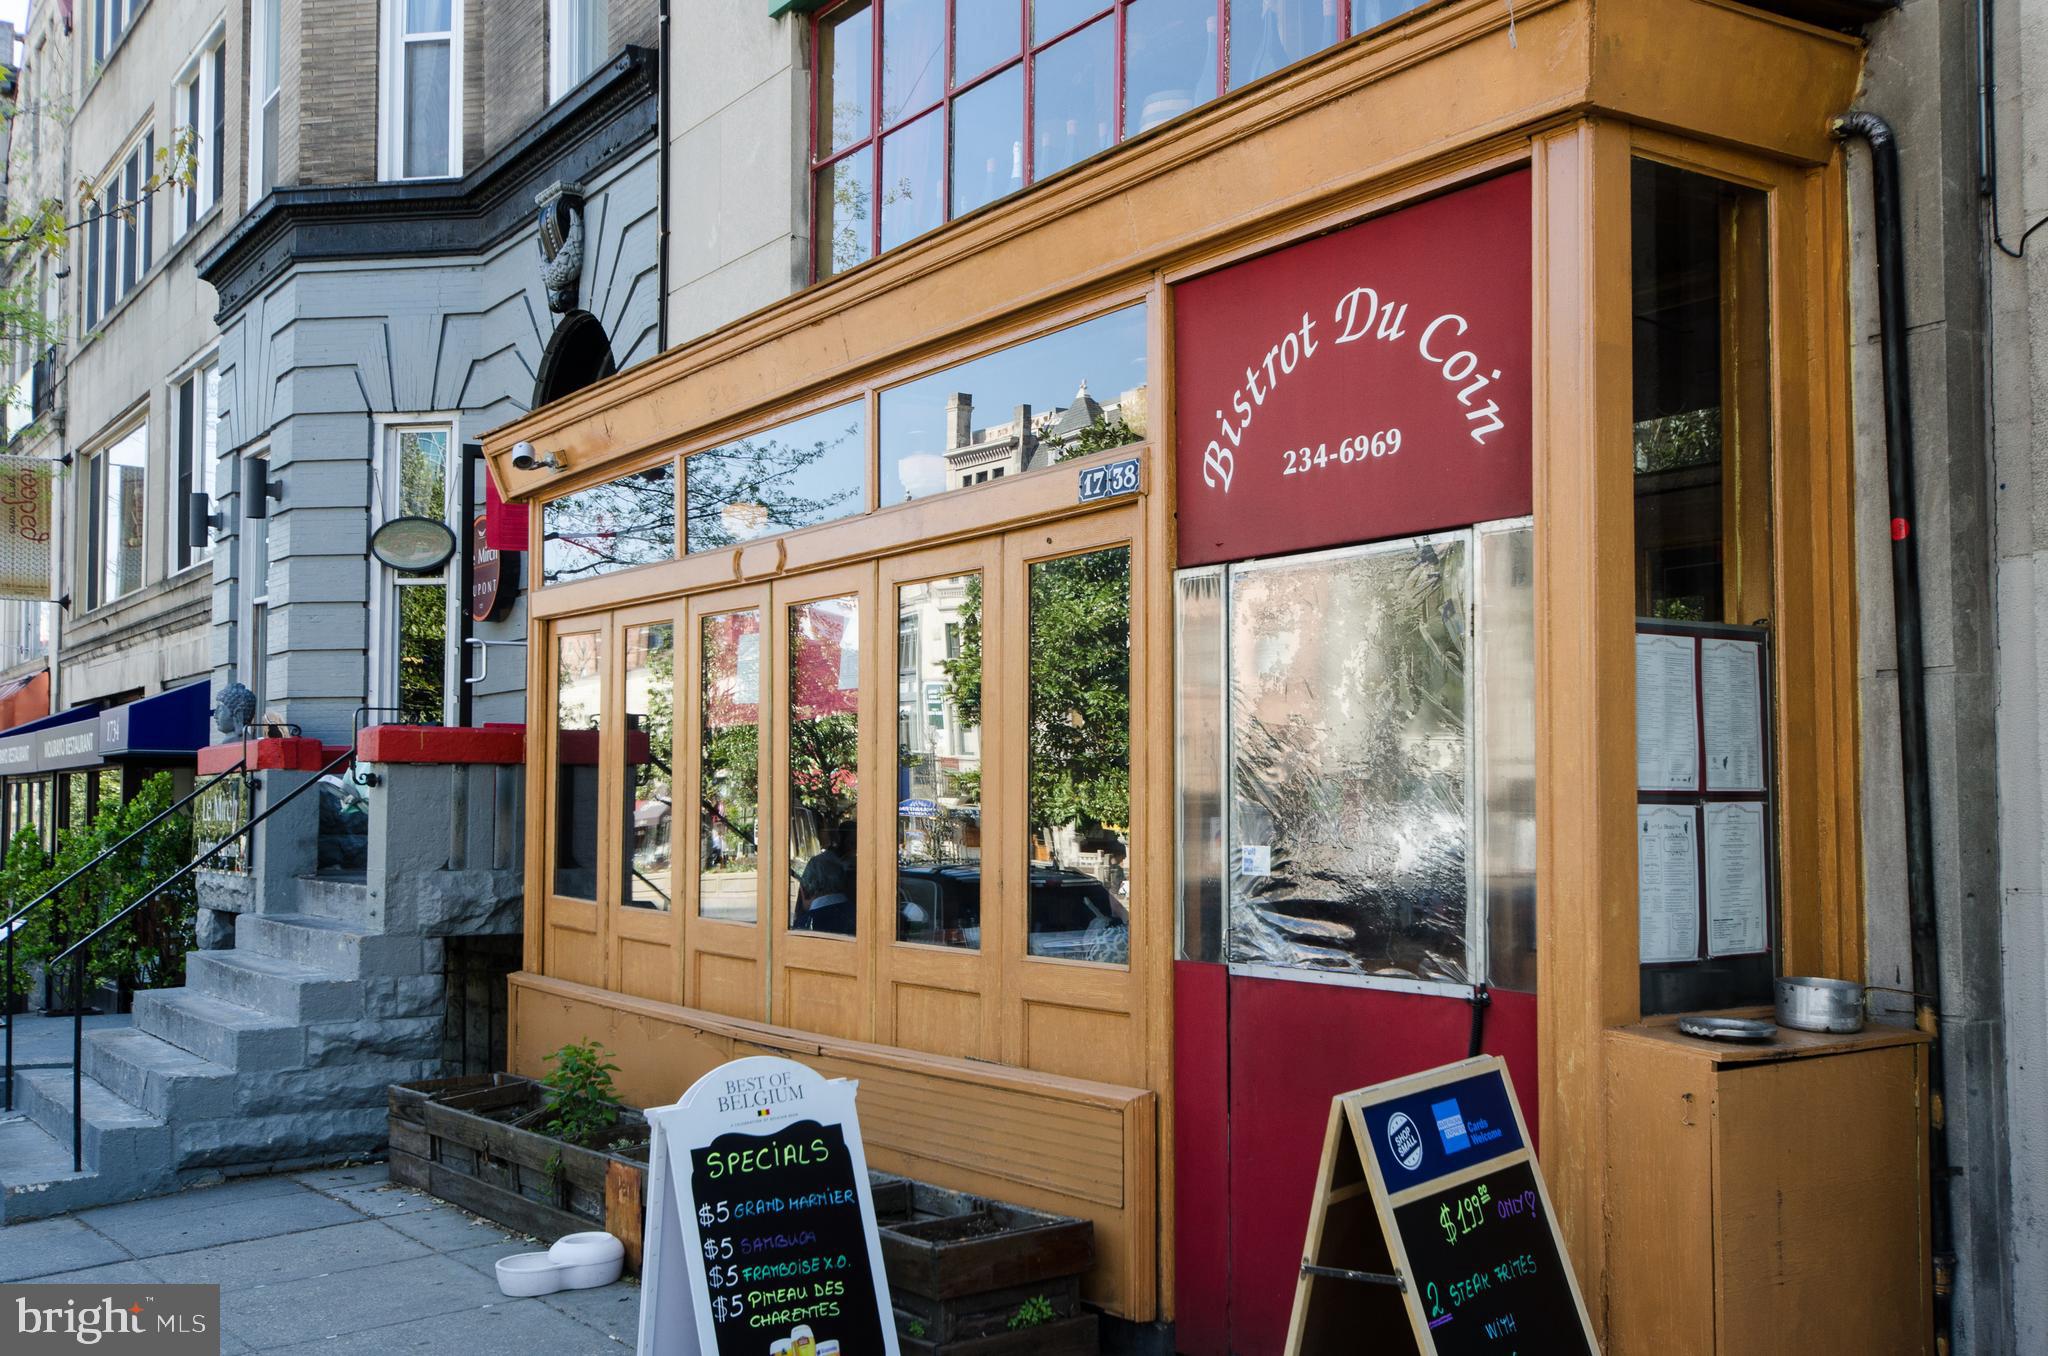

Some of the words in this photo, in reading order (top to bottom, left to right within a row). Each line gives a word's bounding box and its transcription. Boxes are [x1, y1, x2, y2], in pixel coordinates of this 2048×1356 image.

[1203, 312, 1319, 493] Bistrot
[1335, 287, 1408, 345] Du
[1419, 314, 1505, 445] Coin
[1282, 428, 1402, 475] 234-6969
[473, 579, 497, 597] UPONT
[106, 719, 119, 742] 1734
[726, 1076, 765, 1095] BEST
[769, 1071, 792, 1087] OF
[718, 1084, 805, 1113] BELGIUM
[1394, 1126, 1411, 1147] SHOP
[1398, 1135, 1418, 1157] SMALL
[1471, 1128, 1503, 1145] Welcome
[699, 1201, 730, 1227] $5
[734, 1197, 785, 1218] GRAND
[704, 1237, 734, 1260] $5
[709, 1264, 739, 1289] $5
[712, 1294, 744, 1323] $5
[814, 1281, 845, 1297] DES
[1427, 1282, 1444, 1317] 2
[1449, 1273, 1491, 1307] STEAK
